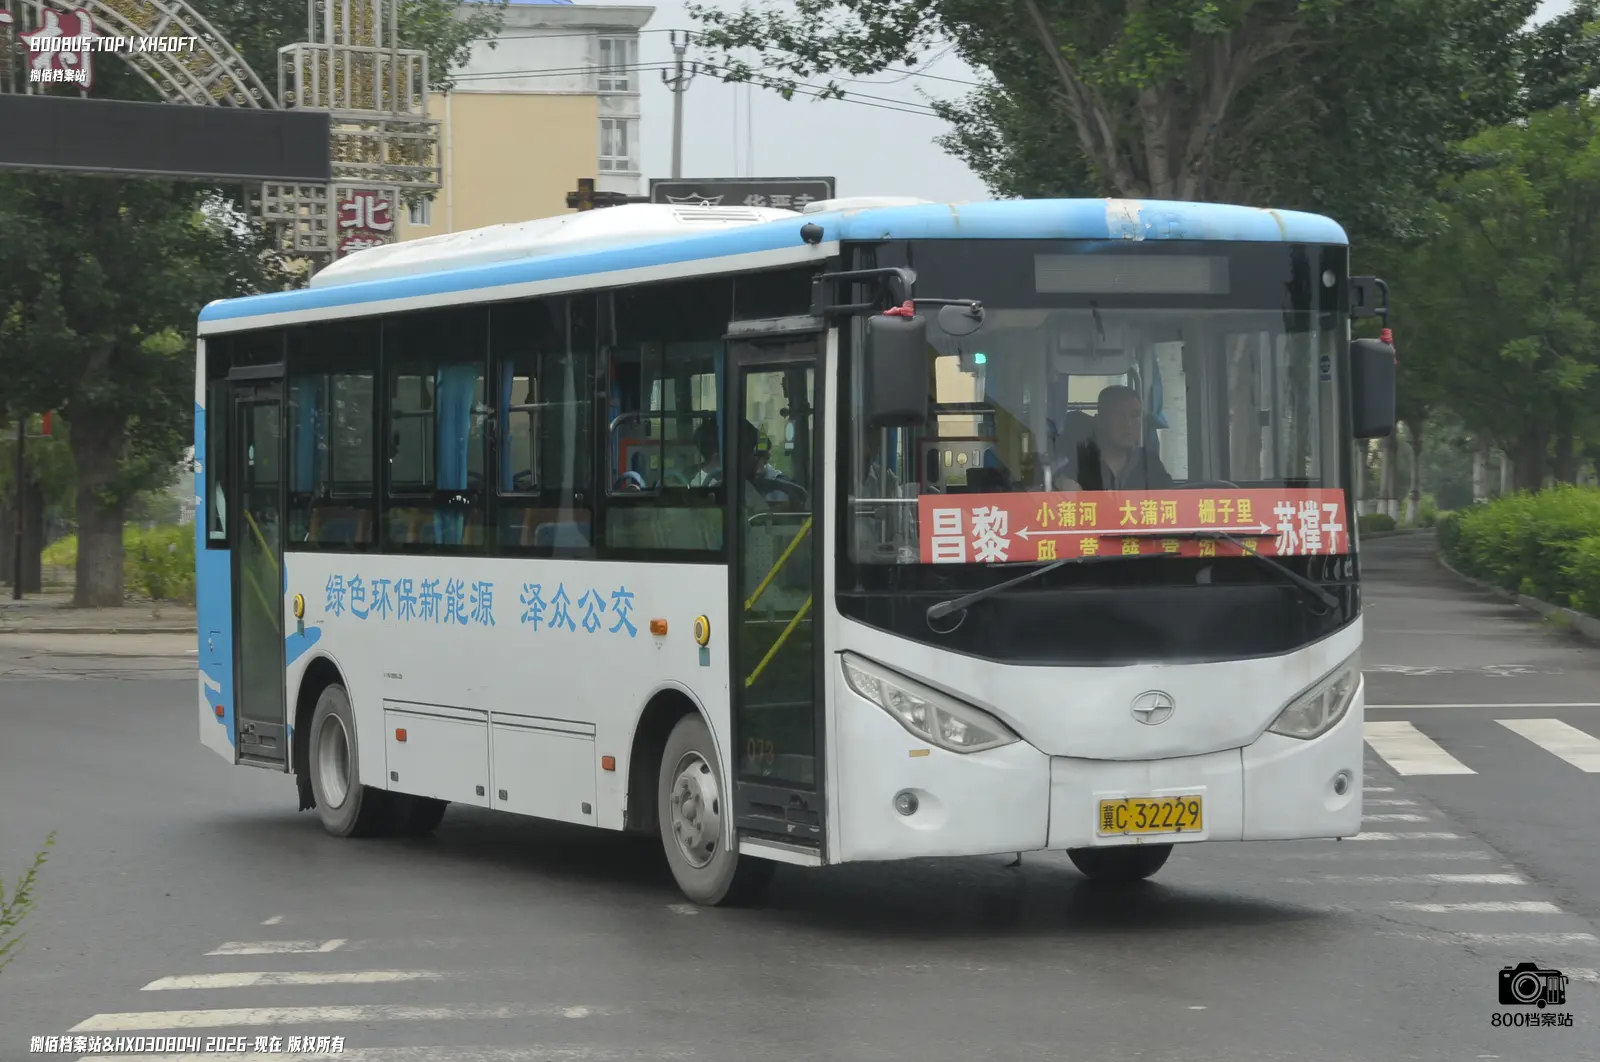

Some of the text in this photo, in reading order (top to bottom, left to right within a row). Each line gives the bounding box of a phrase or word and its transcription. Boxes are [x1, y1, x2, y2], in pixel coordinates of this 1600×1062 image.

[932, 506, 1010, 563] 昌黎
[1036, 498, 1253, 528] 小蒲河 大蒲河 栅子里
[324, 573, 638, 638] 绿色环保新能源 泽众公交
